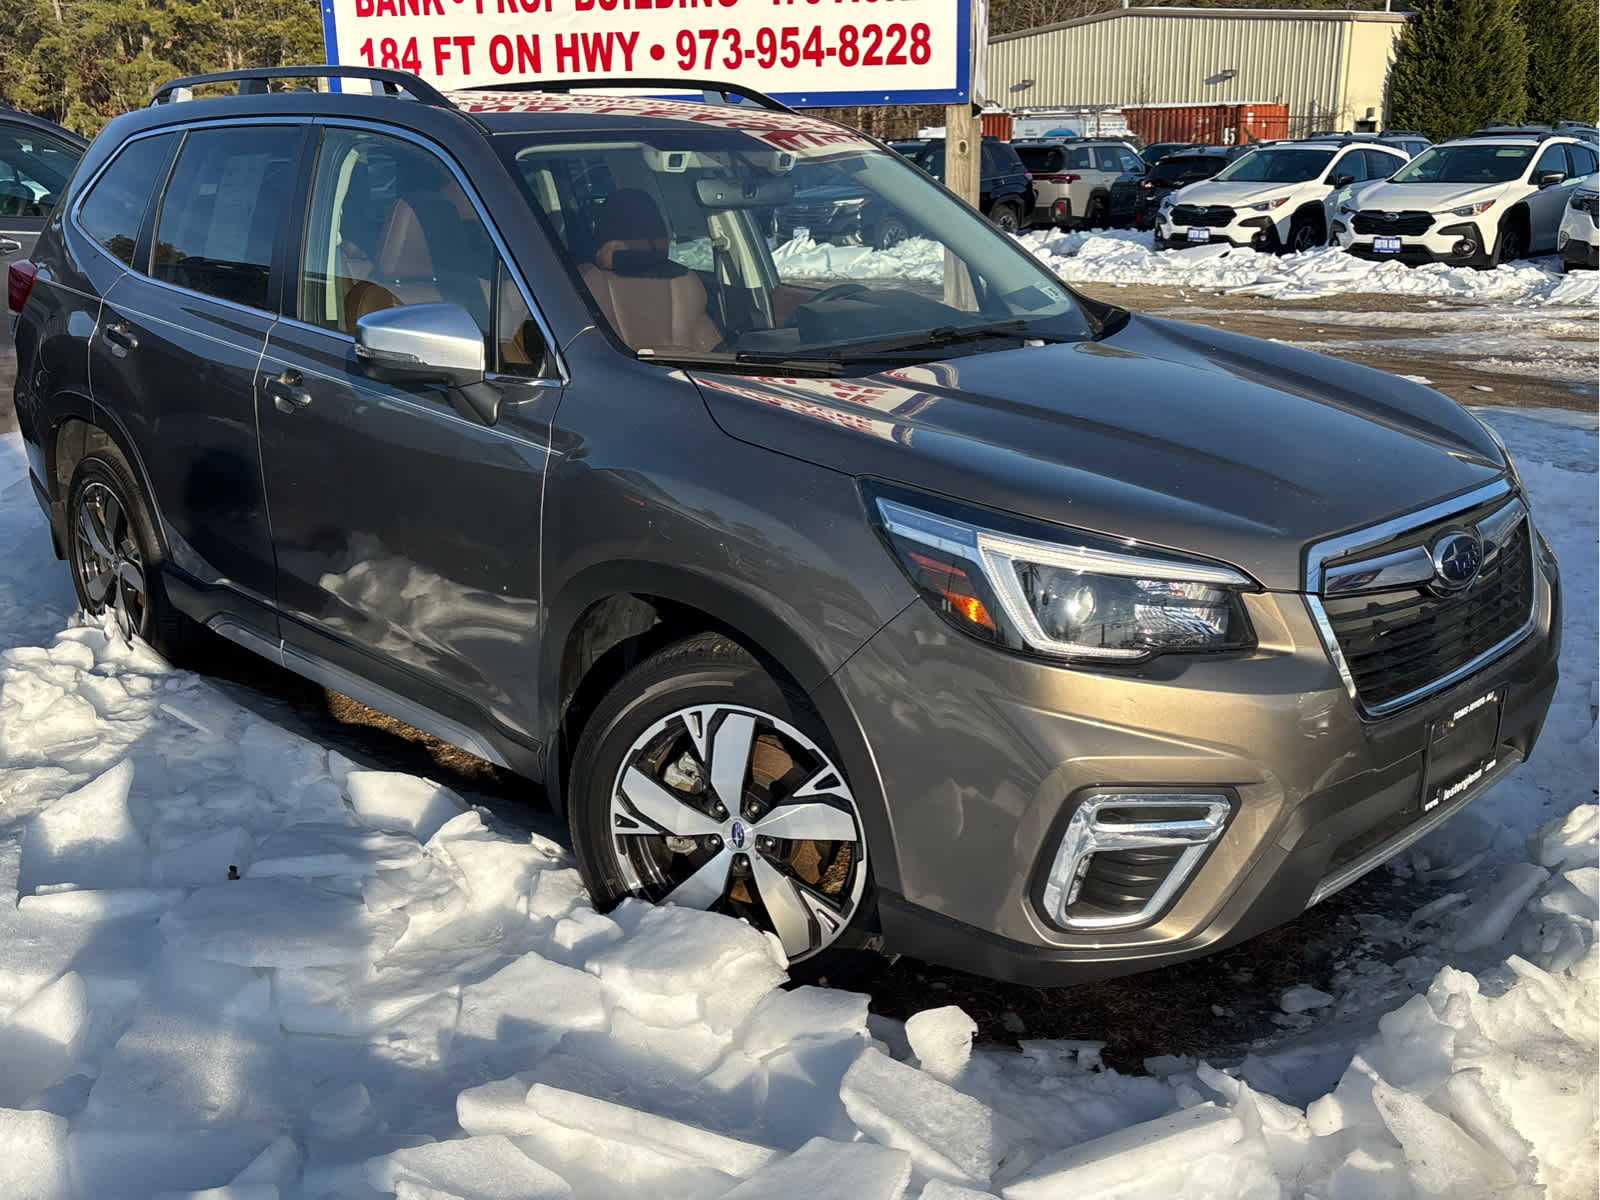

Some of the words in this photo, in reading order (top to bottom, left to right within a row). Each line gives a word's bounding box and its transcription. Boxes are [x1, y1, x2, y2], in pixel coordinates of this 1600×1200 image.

[361, 37, 421, 76] 184
[434, 36, 475, 75] FT
[489, 35, 541, 74] ON
[556, 32, 639, 72] HWY
[676, 23, 931, 70] 973-954-8228
